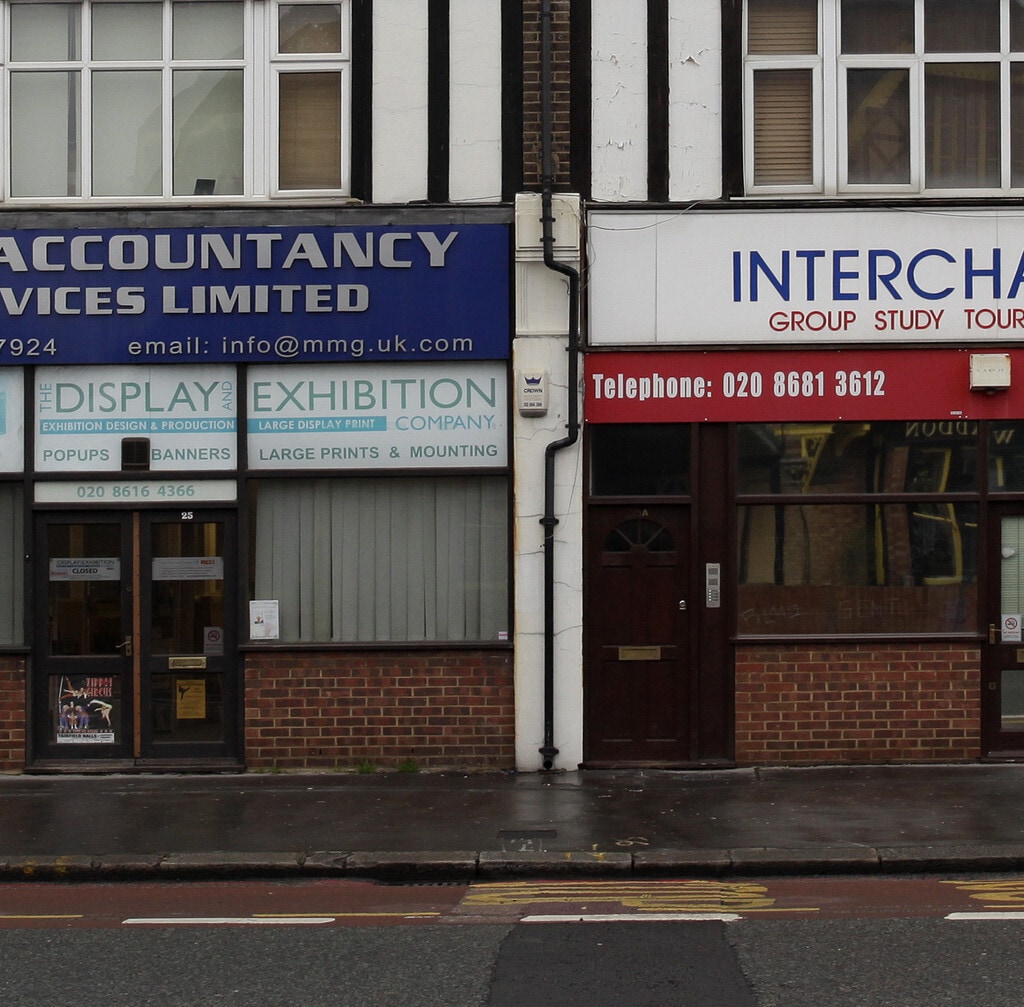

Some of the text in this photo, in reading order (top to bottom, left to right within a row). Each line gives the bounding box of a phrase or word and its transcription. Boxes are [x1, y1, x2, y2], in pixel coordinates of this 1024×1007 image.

[0, 231, 459, 272] ACCOUNTANCY
[162, 284, 369, 314] LIMITED
[769, 310, 857, 332] GROUP
[874, 309, 945, 331] STUDY
[128, 337, 209, 355] email:
[222, 335, 473, 358] info@mmg.uk.com
[592, 370, 886, 401] Telephone: 020 8681 3612
[39, 378, 496, 413] THE DISPLAY AND EXHIBITION
[42, 420, 235, 431] EXHIBITION DESIGN & PRODUCTION
[258, 419, 375, 430] LARGE DISPLAY PRINT
[395, 414, 496, 431] COMPANY
[43, 449, 110, 462] POPUPS
[151, 448, 231, 461] BANNERS
[259, 445, 498, 461] LARGE PRINTS & MOUNTING
[77, 485, 195, 498] 020 8616 4366
[181, 511, 194, 520] 25
